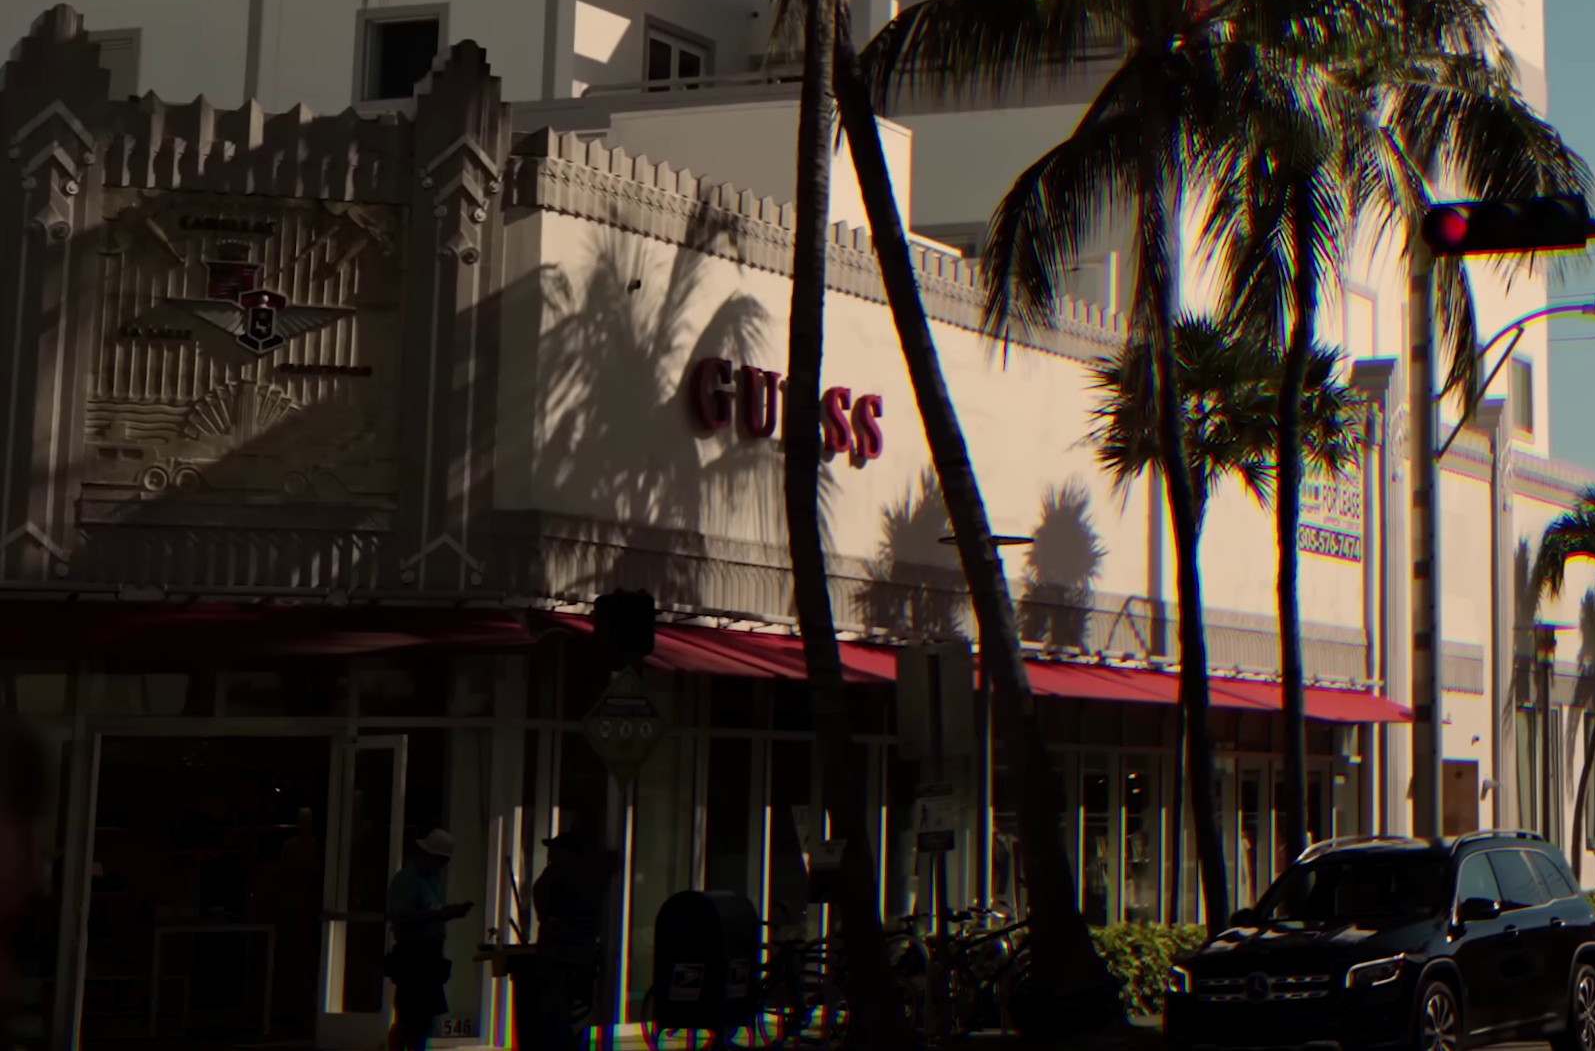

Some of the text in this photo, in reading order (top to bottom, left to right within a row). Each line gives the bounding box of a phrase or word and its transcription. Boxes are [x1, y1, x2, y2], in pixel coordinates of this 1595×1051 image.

[692, 357, 883, 460] GUSS
[1322, 485, 1338, 514] FOR
[1338, 490, 1360, 520] LEASE
[1298, 526, 1361, 560] 305-576-7474
[444, 1019, 471, 1035] 546
